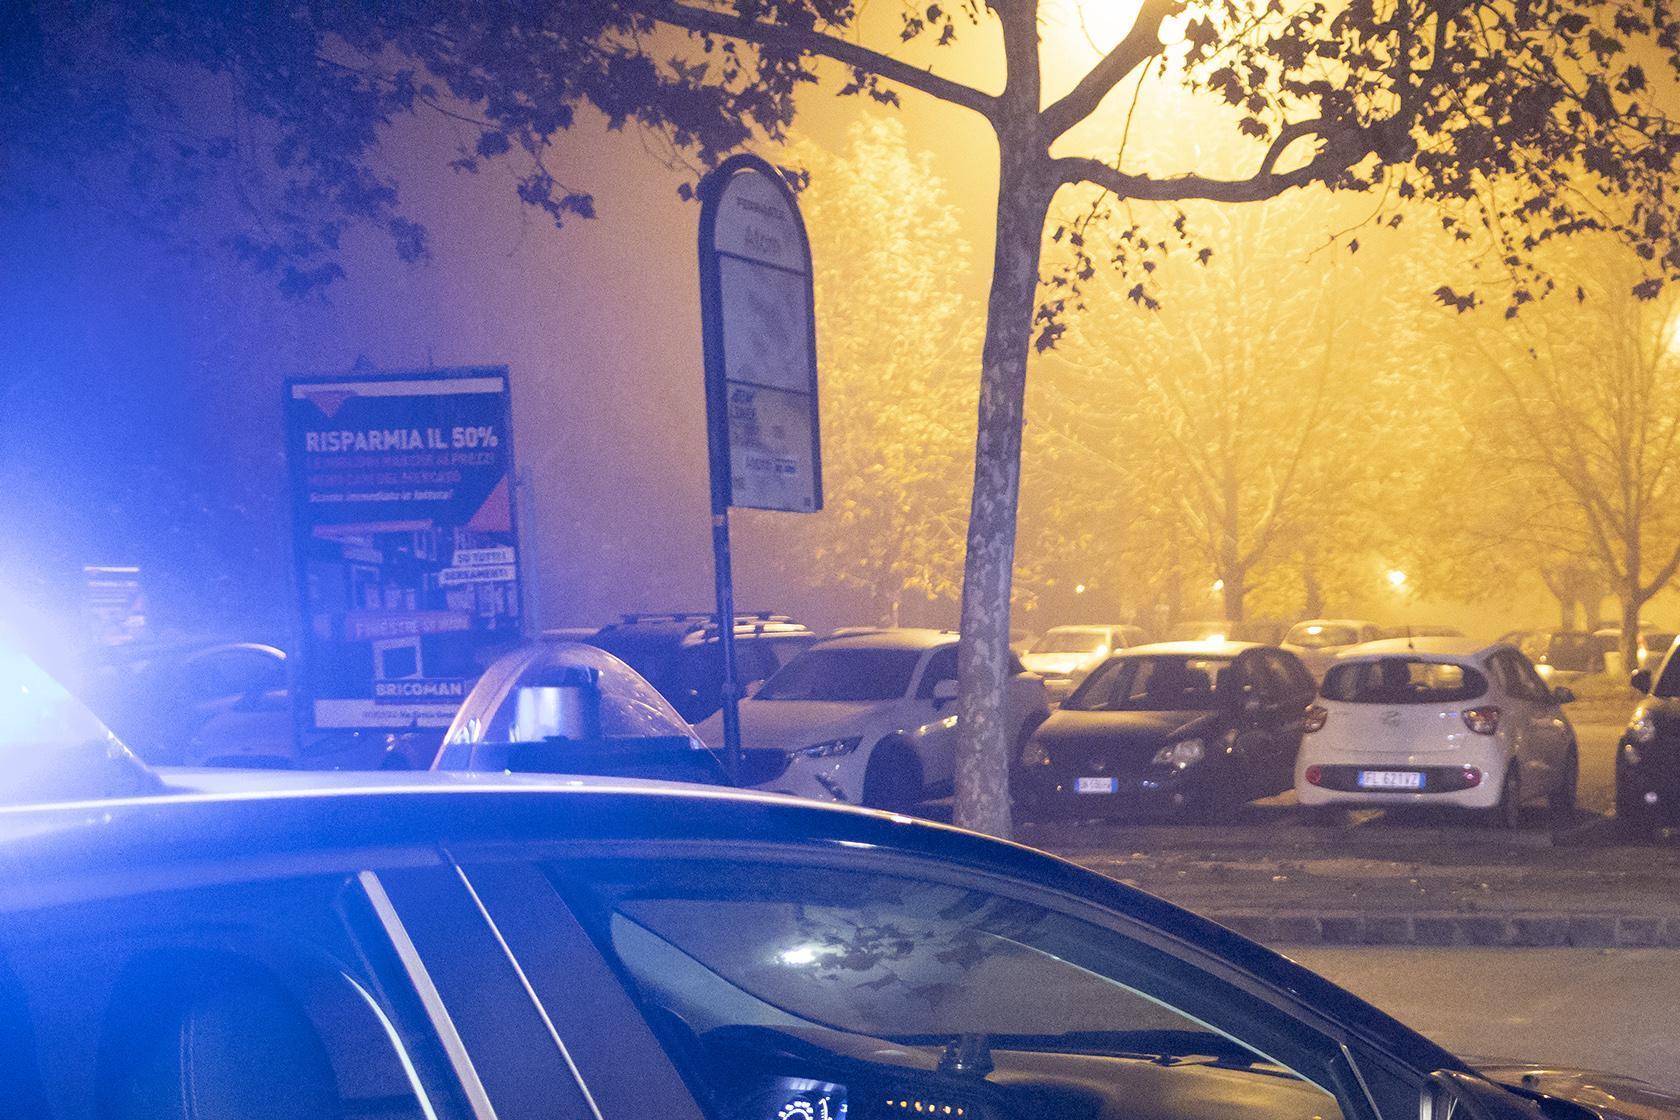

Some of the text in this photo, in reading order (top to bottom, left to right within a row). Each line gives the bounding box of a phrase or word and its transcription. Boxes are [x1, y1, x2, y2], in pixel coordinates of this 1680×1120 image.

[306, 426, 498, 452] RISPARMIA IL 50%
[376, 683, 462, 696] BRICOMAN
